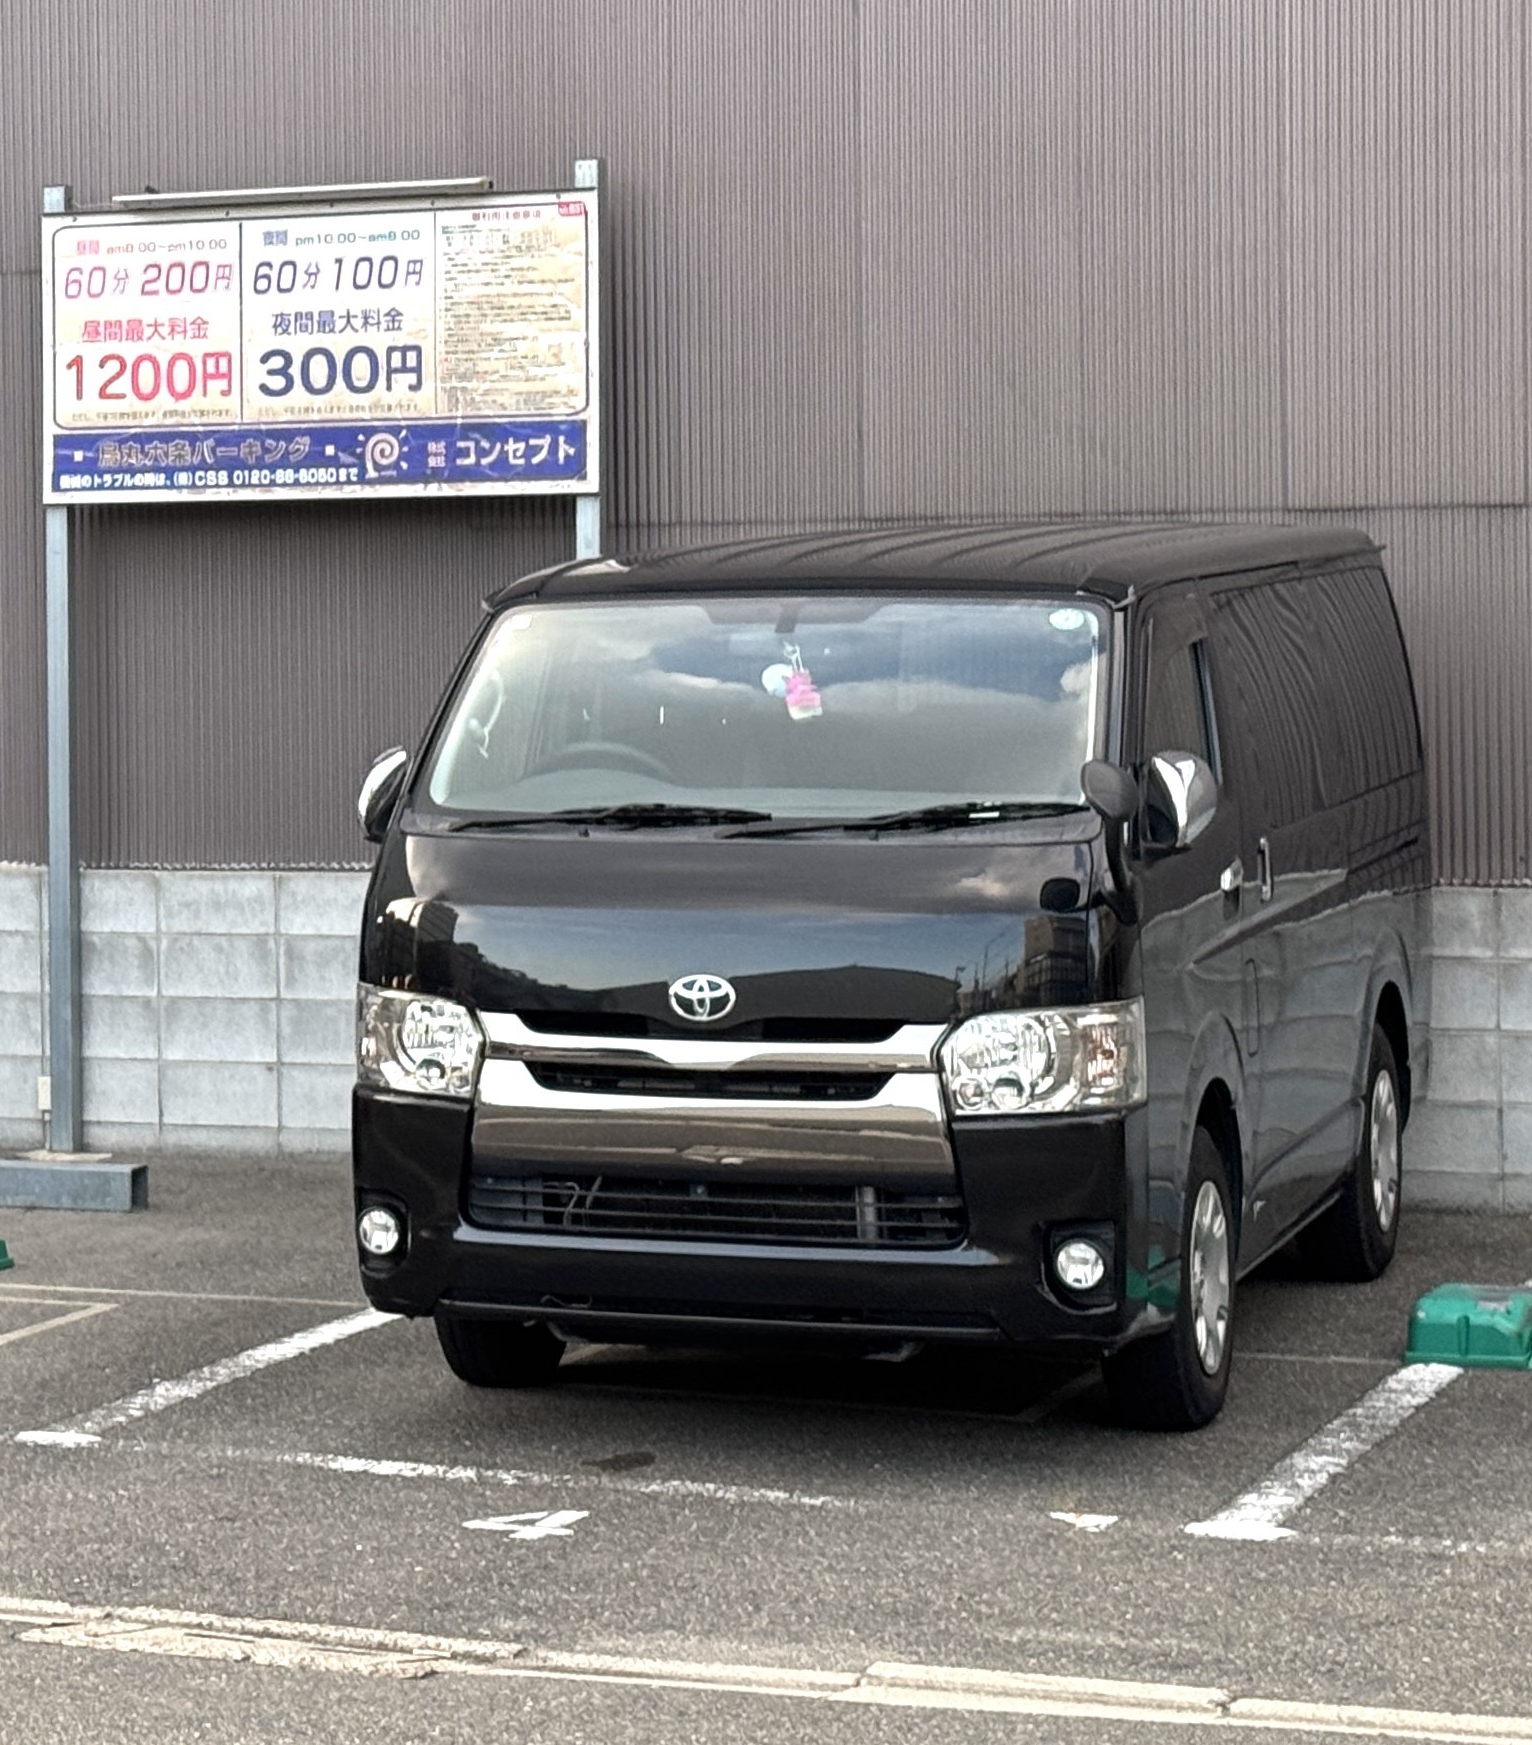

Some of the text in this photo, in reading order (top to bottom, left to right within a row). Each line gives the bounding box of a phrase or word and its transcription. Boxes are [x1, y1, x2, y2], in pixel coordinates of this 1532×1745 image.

[65, 261, 234, 299] 60分 200円
[253, 261, 320, 295] 60分
[334, 255, 424, 291] 100円
[82, 316, 209, 343] 昼間最大料金
[272, 307, 404, 336] 夜間最大料金
[66, 351, 232, 401] 1200円
[259, 345, 423, 397] 300円
[456, 434, 575, 465] コンセプト
[462, 1510, 590, 1539] 4
